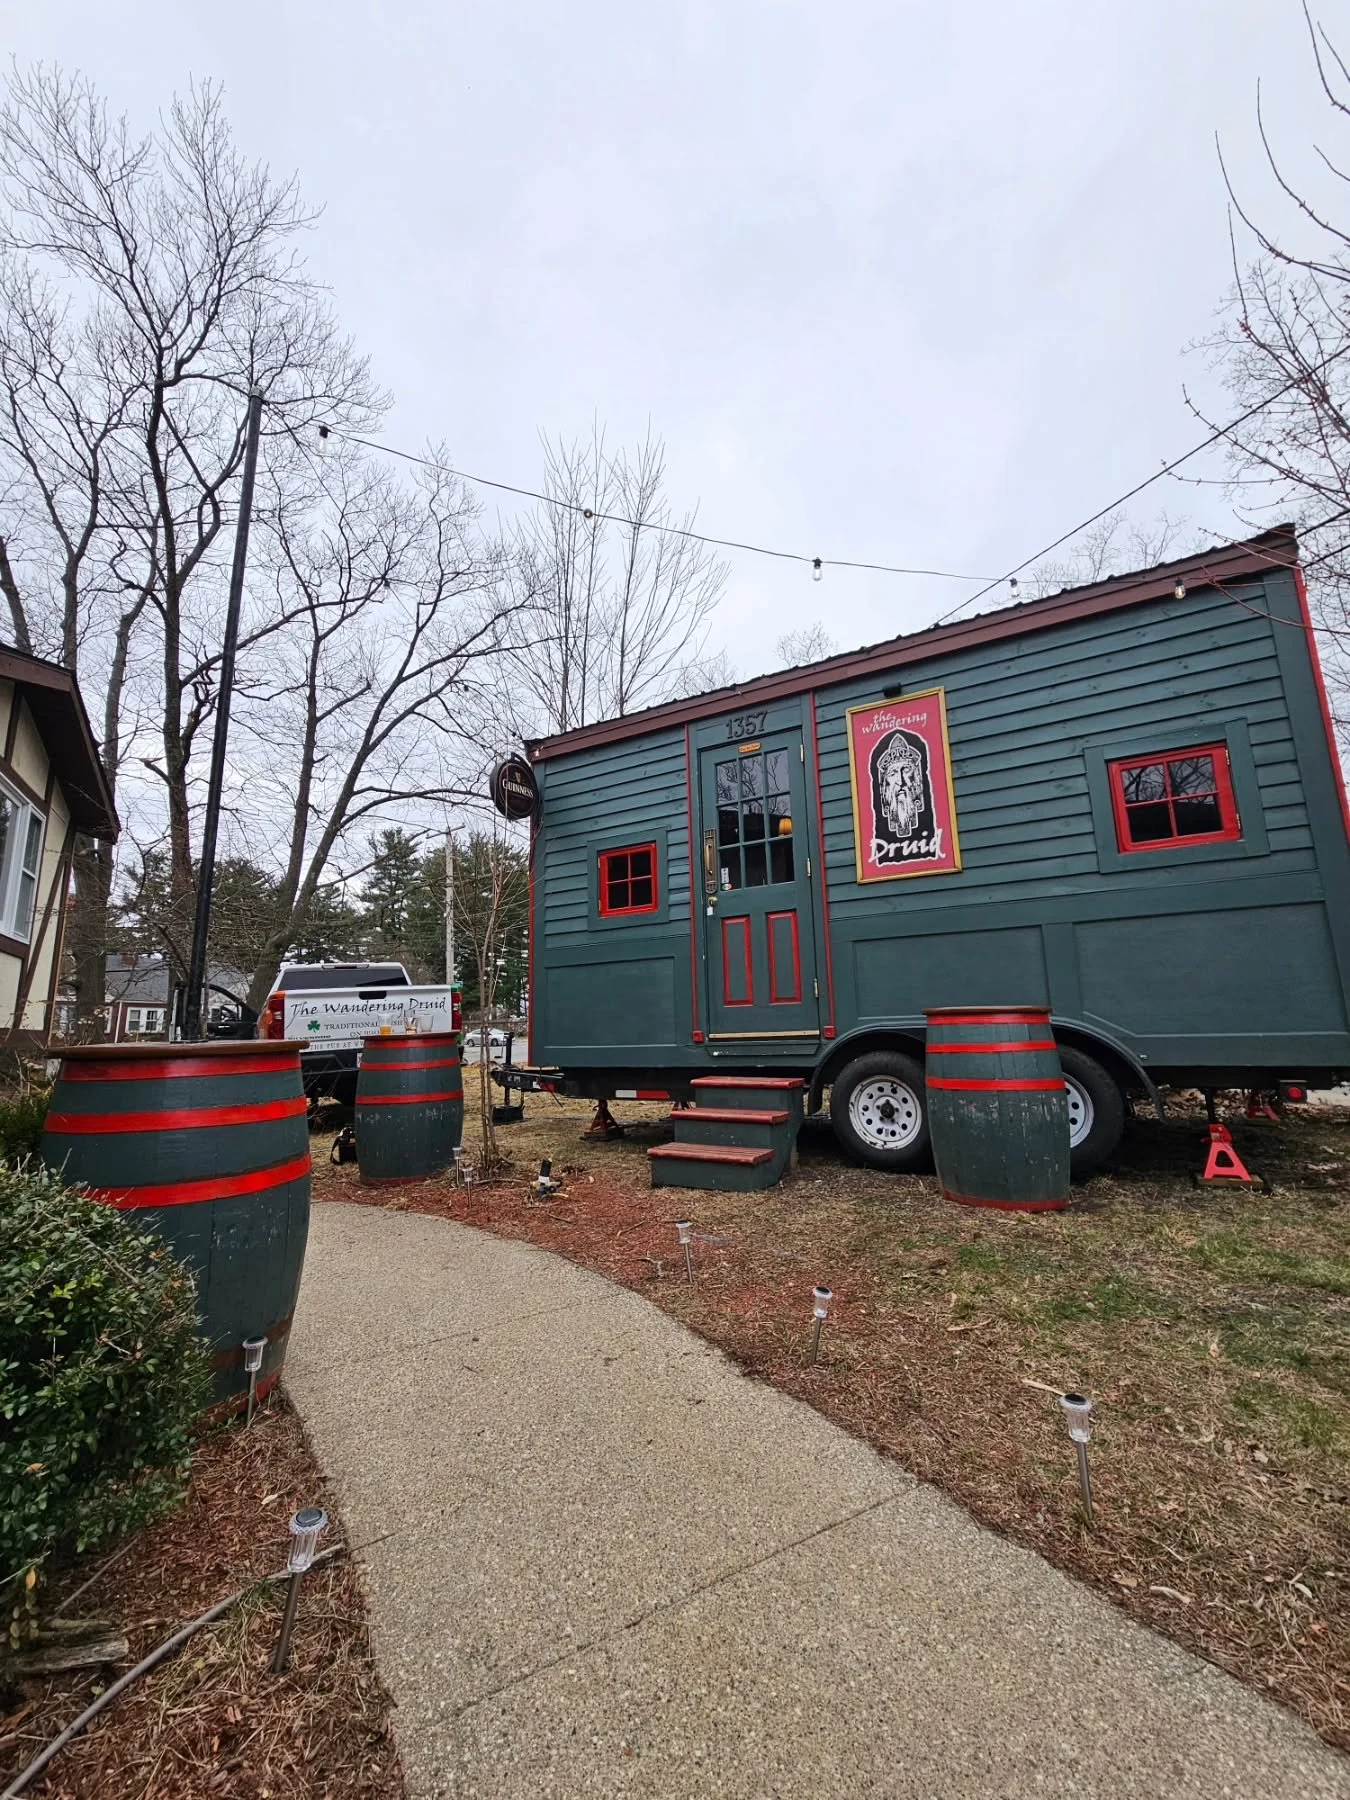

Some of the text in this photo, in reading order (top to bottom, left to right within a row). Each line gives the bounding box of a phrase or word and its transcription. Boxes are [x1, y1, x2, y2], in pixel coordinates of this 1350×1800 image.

[726, 710, 767, 739] 1357
[862, 712, 927, 734] wandering
[873, 710, 892, 723] the
[868, 828, 946, 863] Druid
[285, 997, 447, 1027] The Wandering Druid
[324, 1021, 379, 1030] TRADITIONAL
